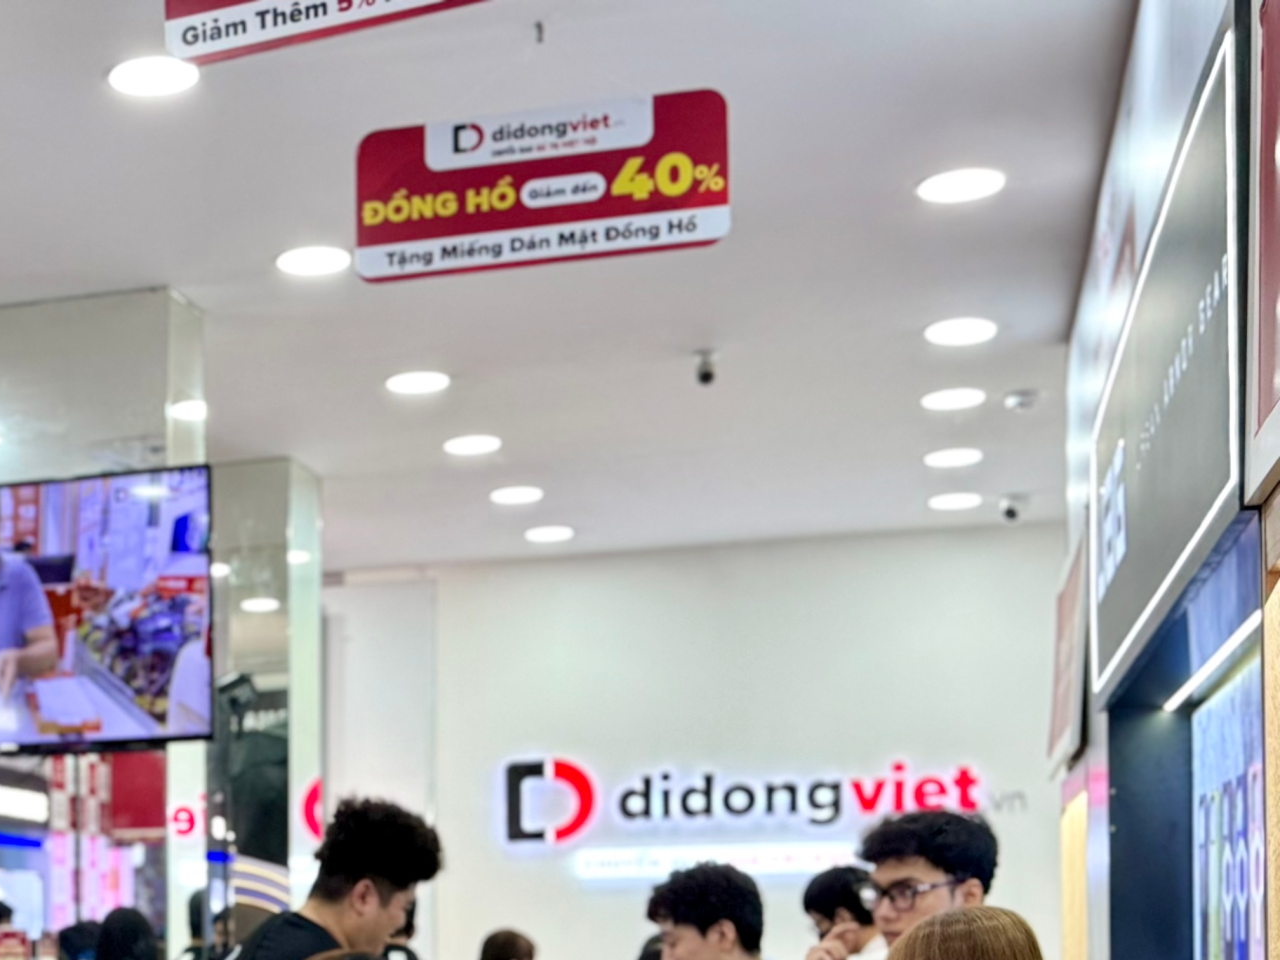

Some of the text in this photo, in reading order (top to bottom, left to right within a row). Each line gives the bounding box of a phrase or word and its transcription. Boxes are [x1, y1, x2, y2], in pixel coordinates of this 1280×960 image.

[181, 18, 247, 46] Giảm
[255, 1, 328, 31] Thêm
[491, 113, 610, 145] didongviet
[528, 180, 599, 200] Giảm đến
[610, 151, 726, 200] 40%
[362, 175, 517, 227] ĐỒNG HỒ
[385, 249, 434, 272] Tặng
[440, 239, 503, 262] Miếng
[510, 233, 551, 253] Dán
[557, 228, 599, 251] Mặt
[605, 221, 661, 244] Đồng
